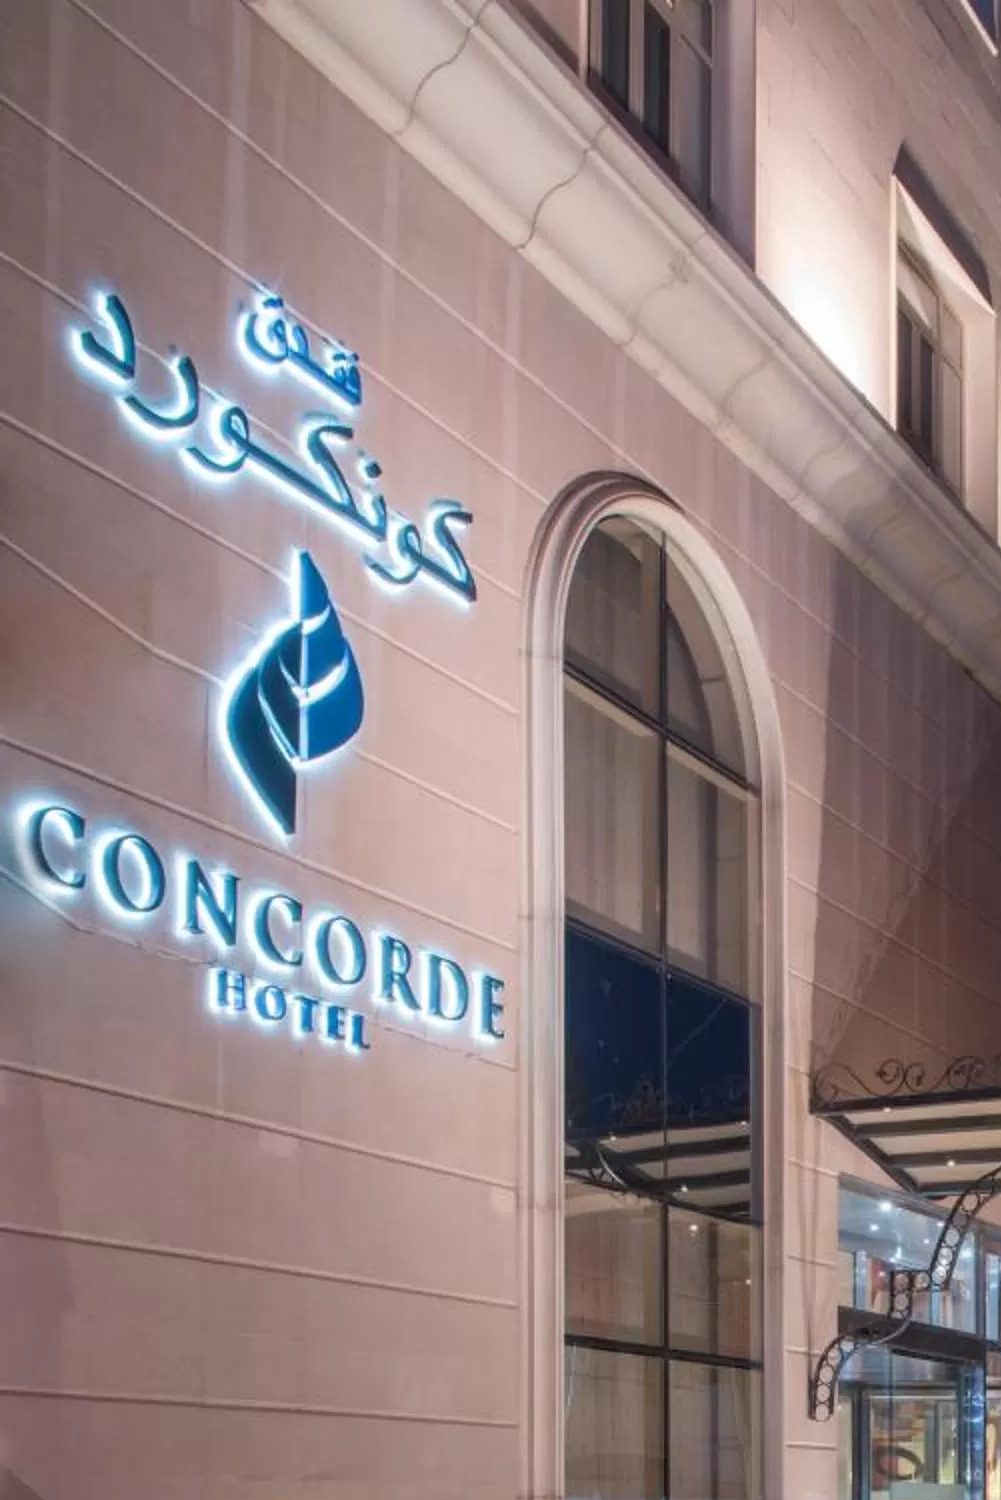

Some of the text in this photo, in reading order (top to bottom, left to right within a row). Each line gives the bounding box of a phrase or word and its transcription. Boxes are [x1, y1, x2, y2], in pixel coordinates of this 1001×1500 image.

[241, 296, 362, 406] فندق
[79, 294, 478, 602] كونكورد
[28, 804, 506, 1040] CONCORDE
[212, 966, 371, 1050] HOTEL
